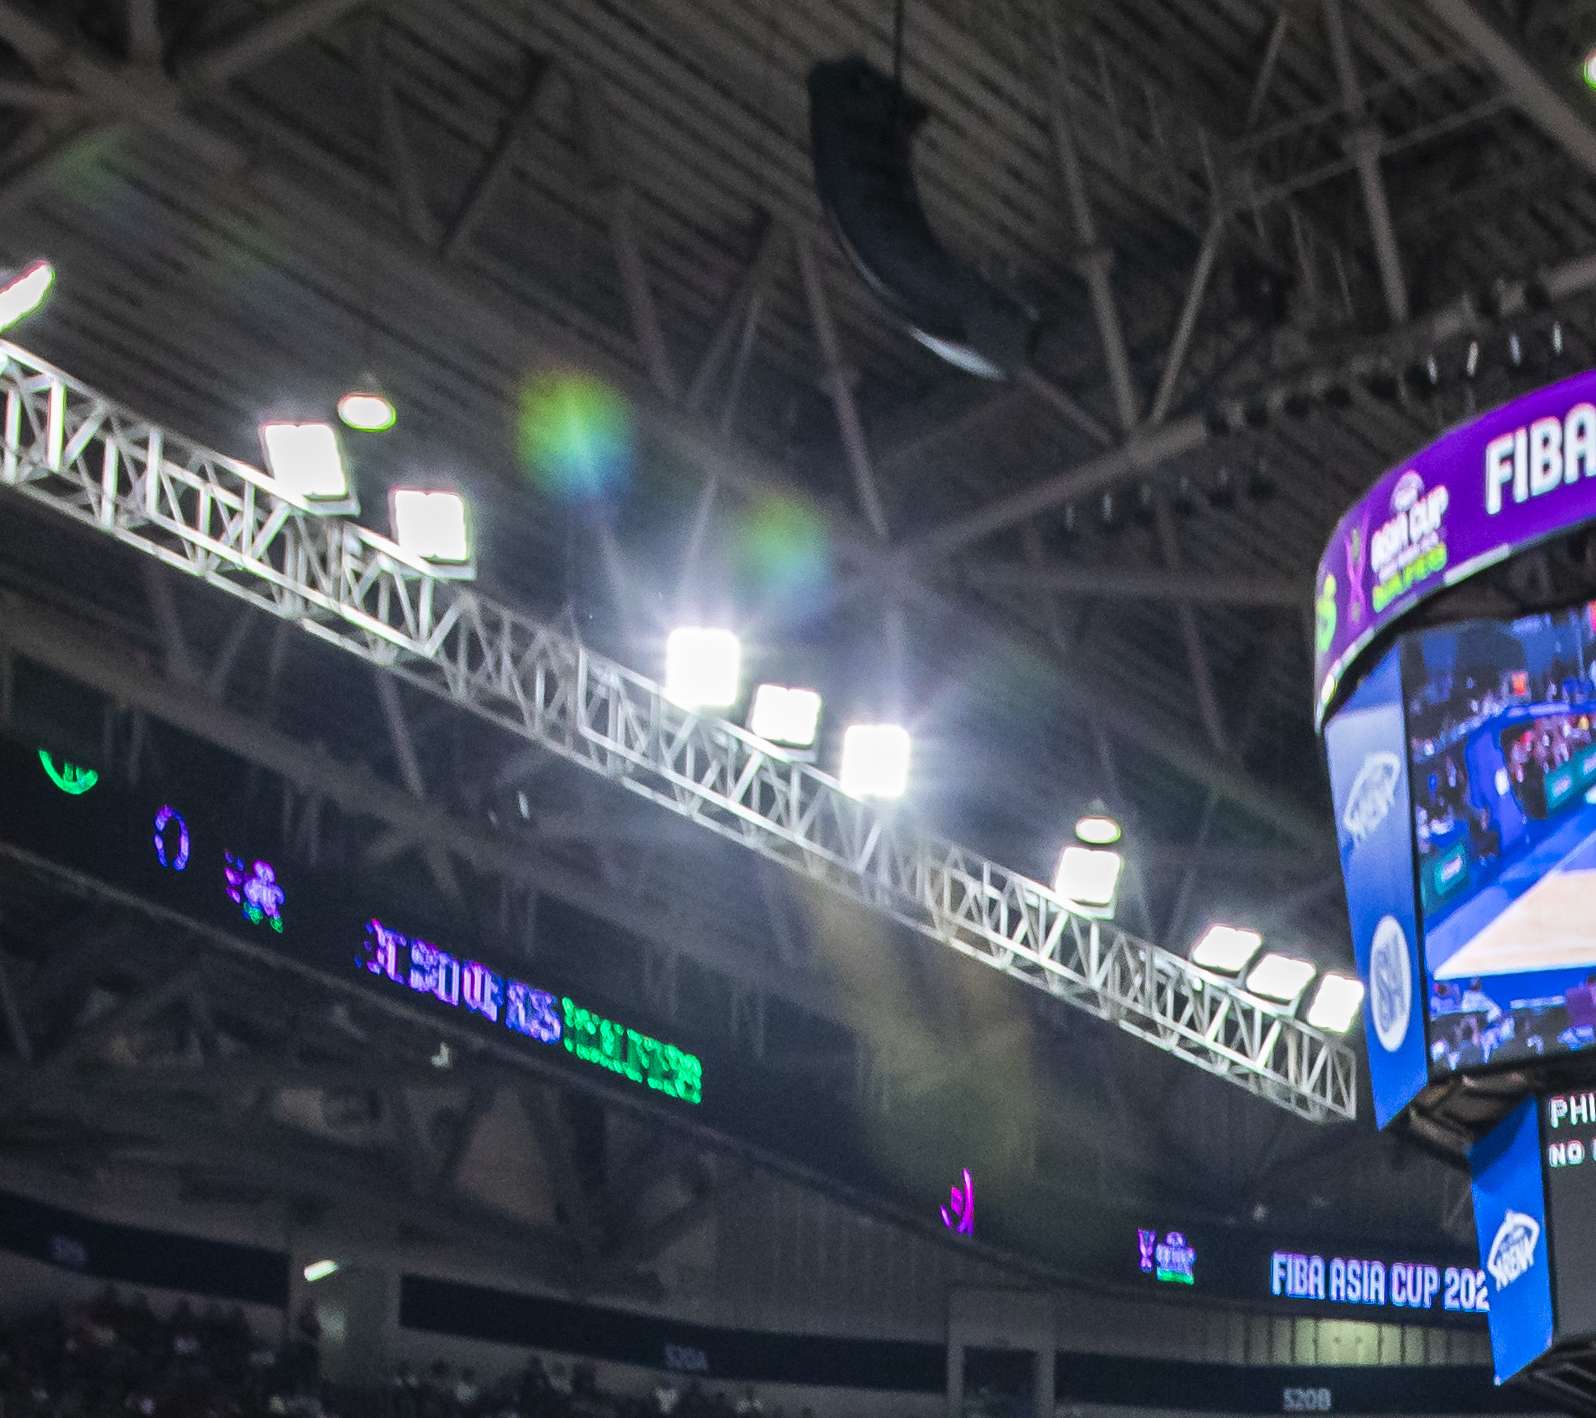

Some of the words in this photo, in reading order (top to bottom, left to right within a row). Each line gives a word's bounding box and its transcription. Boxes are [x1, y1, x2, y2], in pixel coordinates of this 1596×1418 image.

[1548, 1138, 1585, 1168] NO
[1270, 1250, 1325, 1299] FIBA
[1328, 1256, 1386, 1306] ASIA
[1390, 1262, 1441, 1310] CUP
